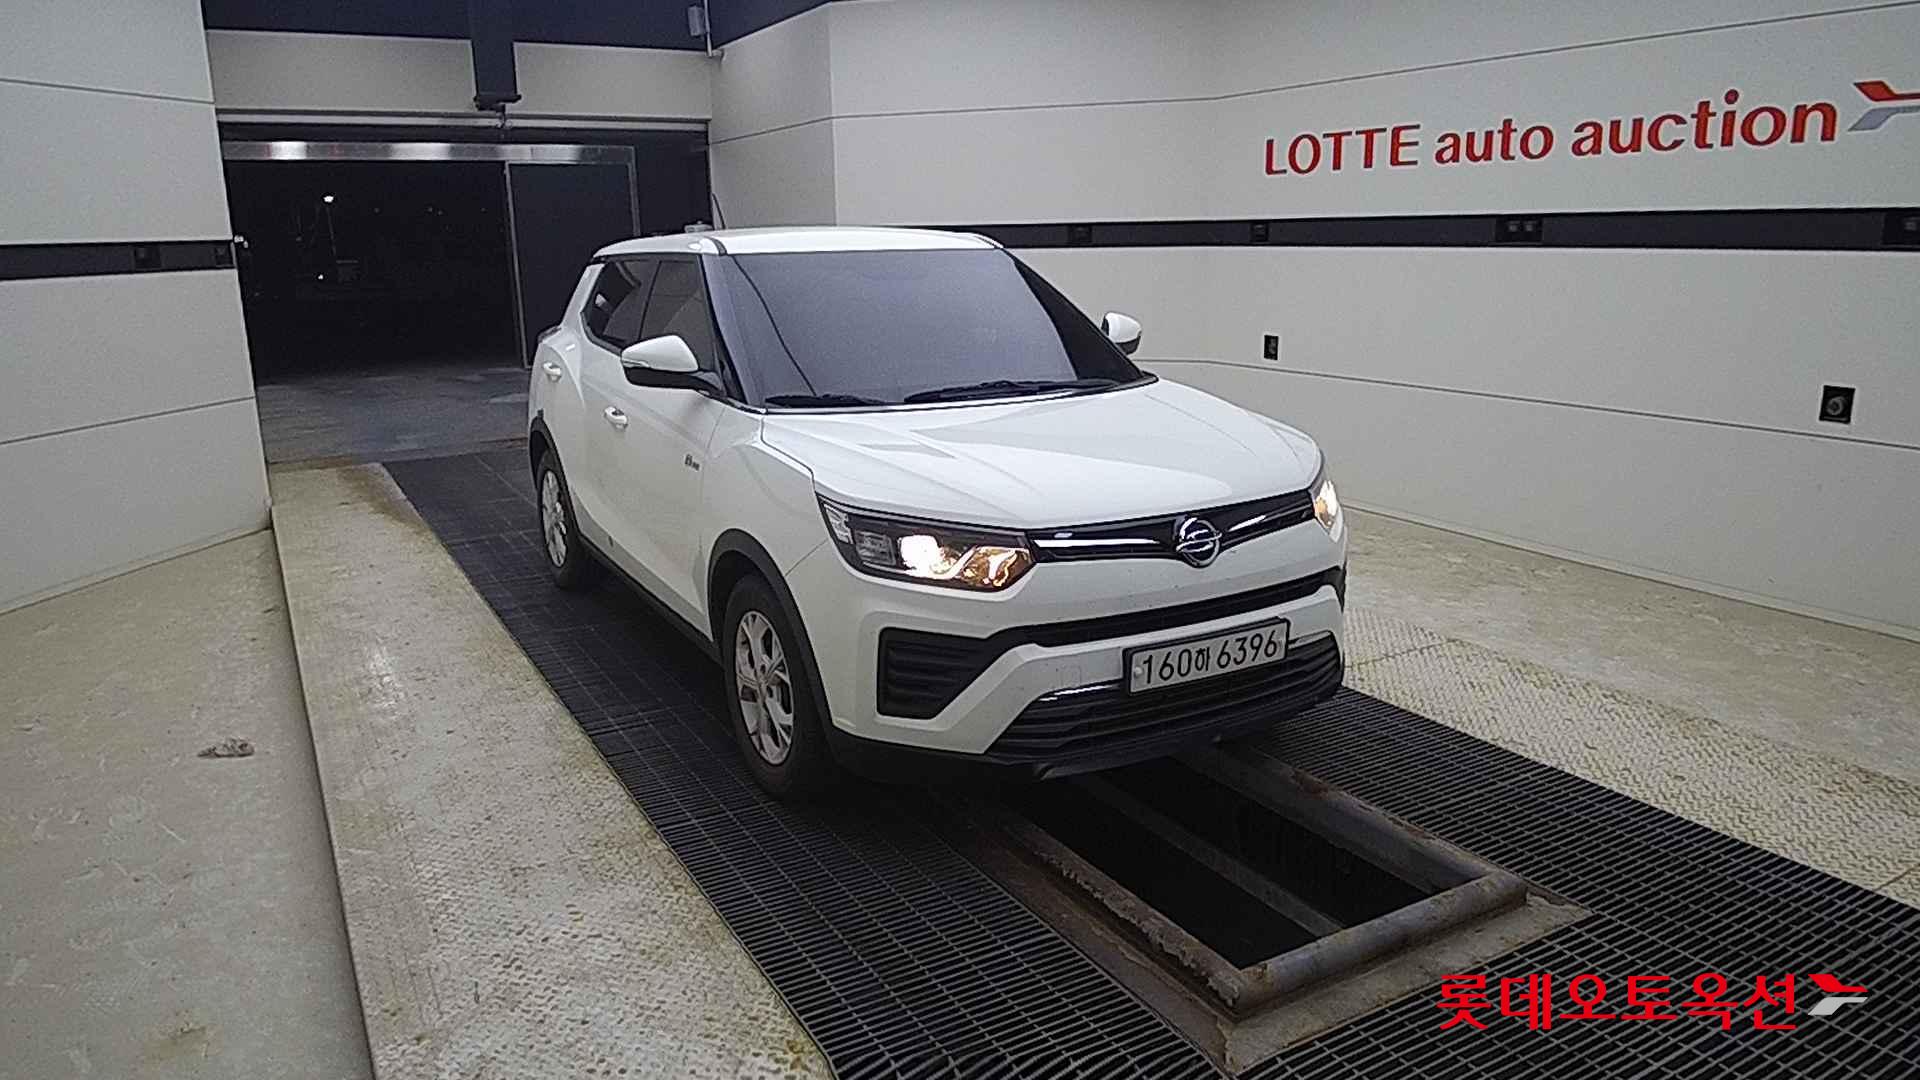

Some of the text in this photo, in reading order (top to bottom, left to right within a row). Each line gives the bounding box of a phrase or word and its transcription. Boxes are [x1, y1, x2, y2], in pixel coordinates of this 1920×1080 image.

[1265, 89, 1838, 176] LOTTE auto auction
